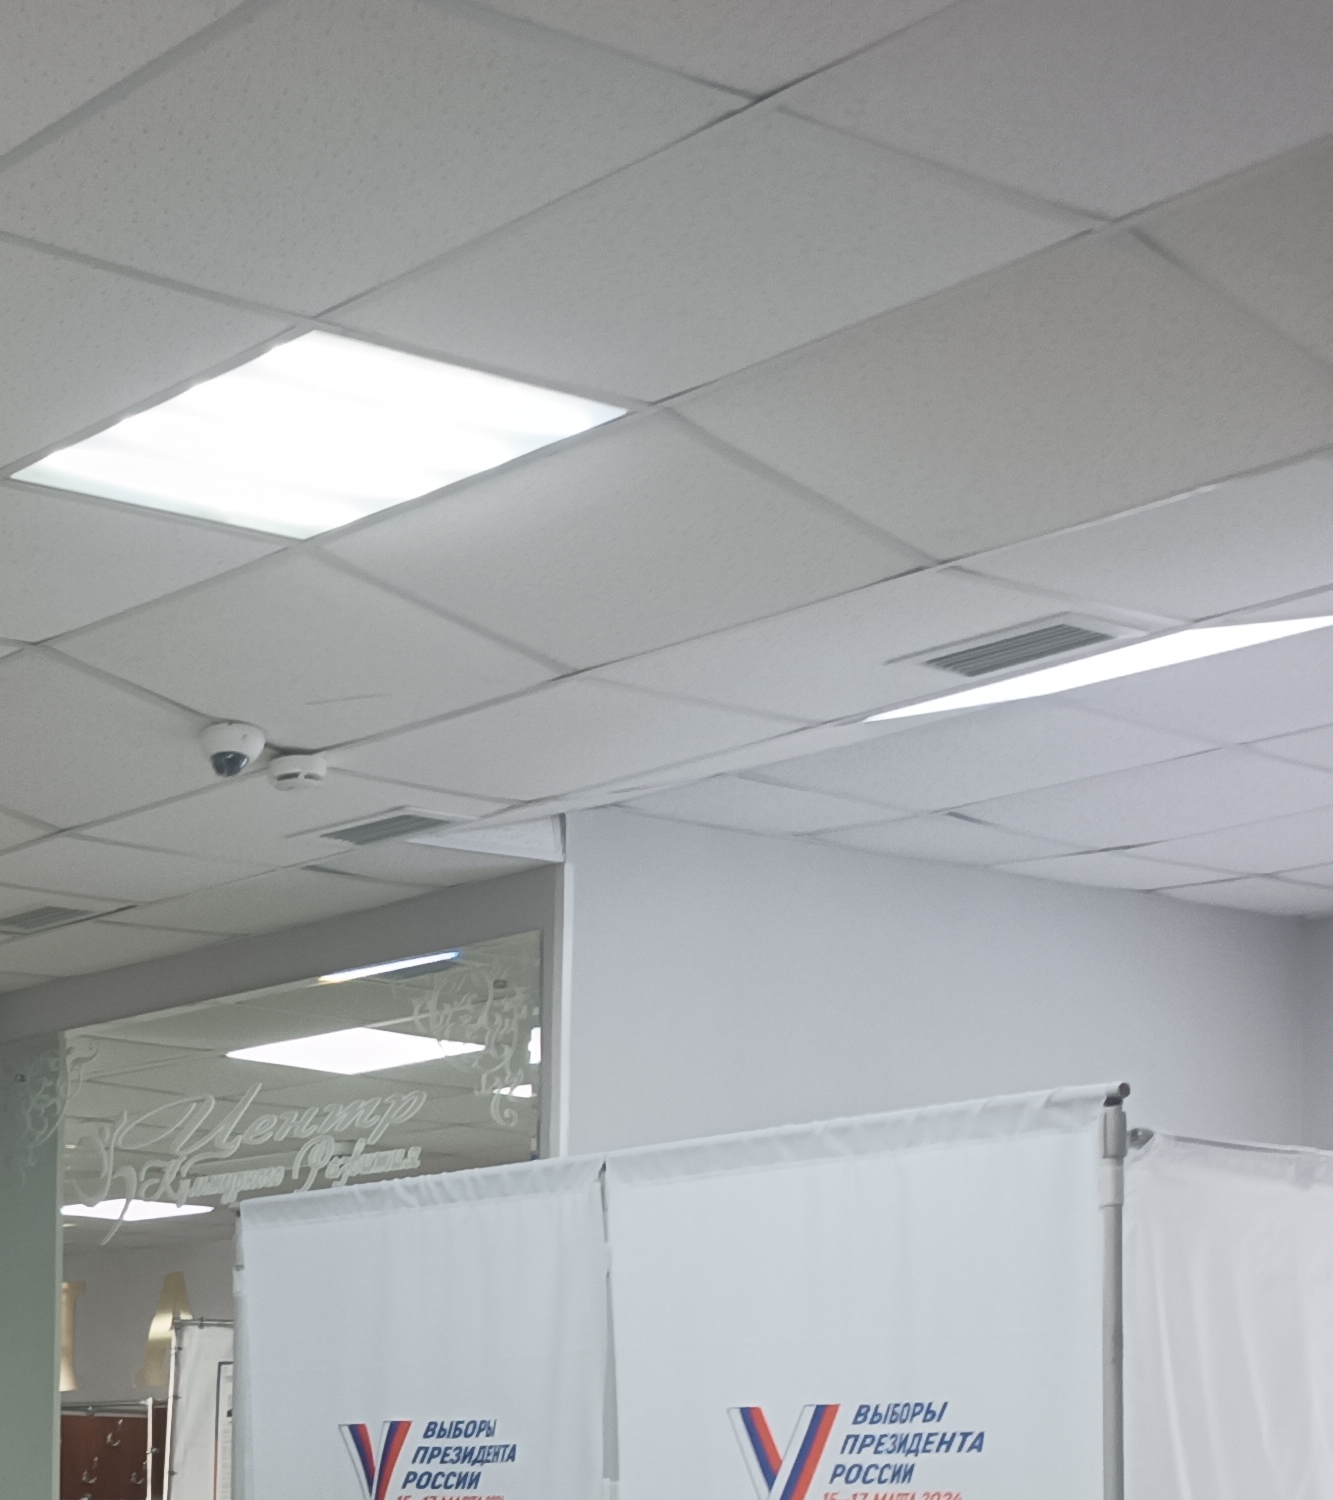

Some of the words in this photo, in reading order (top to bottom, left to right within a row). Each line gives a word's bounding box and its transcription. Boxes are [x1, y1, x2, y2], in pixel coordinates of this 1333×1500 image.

[117, 1083, 428, 1161] Центр
[851, 1402, 948, 1425] ВЫБОРЫ
[423, 1418, 497, 1439] ВЫБОРЫ
[840, 1430, 986, 1456] ПРЕЗИДЕНТА
[411, 1443, 517, 1467] ПРЕЗИДЕНТА
[402, 1471, 482, 1491] РОССИИ
[829, 1463, 916, 1486] РОССИИ
